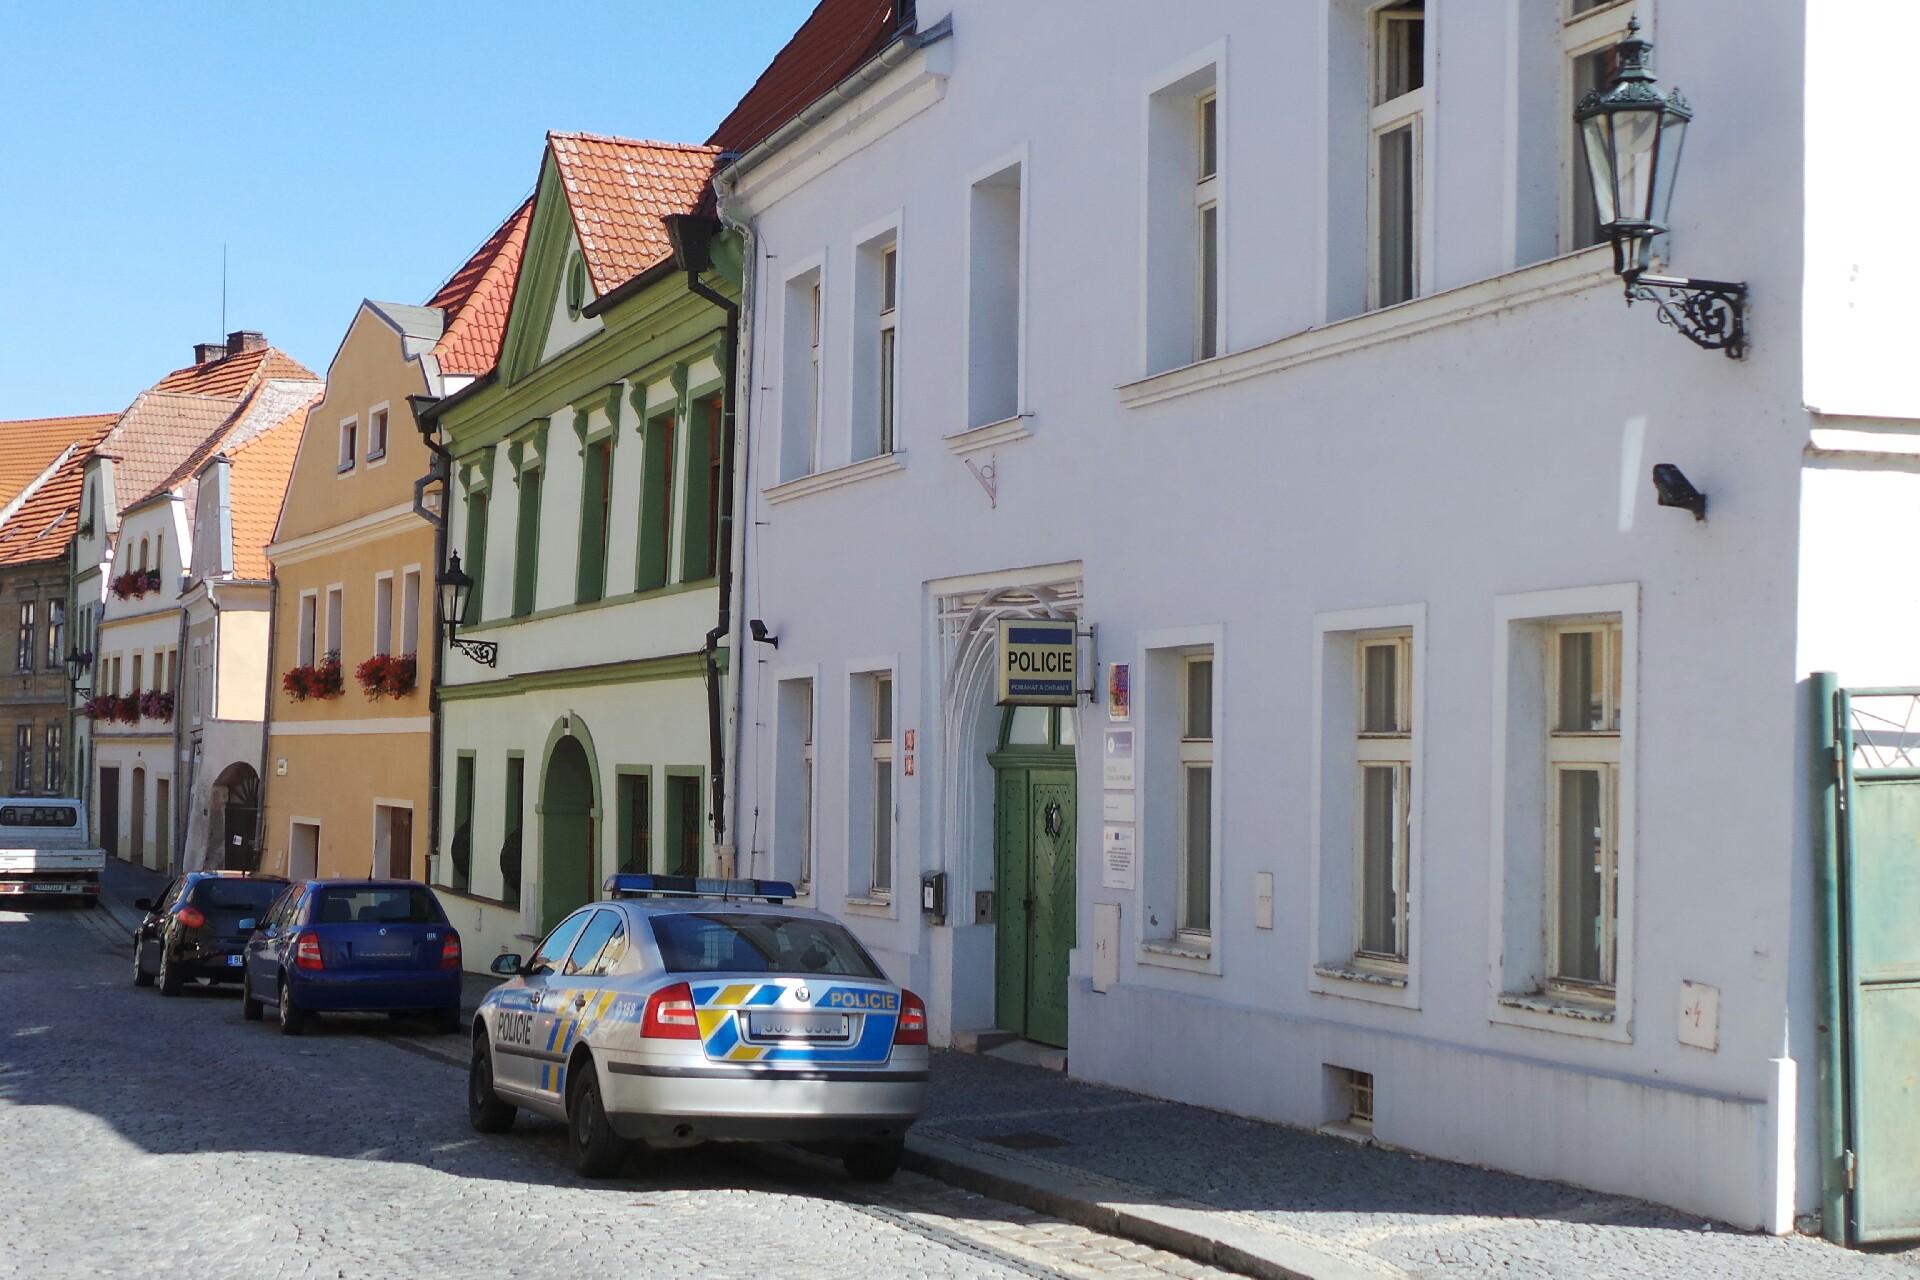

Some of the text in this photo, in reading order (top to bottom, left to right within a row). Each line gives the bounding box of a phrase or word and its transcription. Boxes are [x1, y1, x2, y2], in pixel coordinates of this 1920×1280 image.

[1008, 651, 1072, 673] POLICIE
[831, 992, 896, 1009] POLICIE
[498, 1012, 533, 1044] POLICIE
